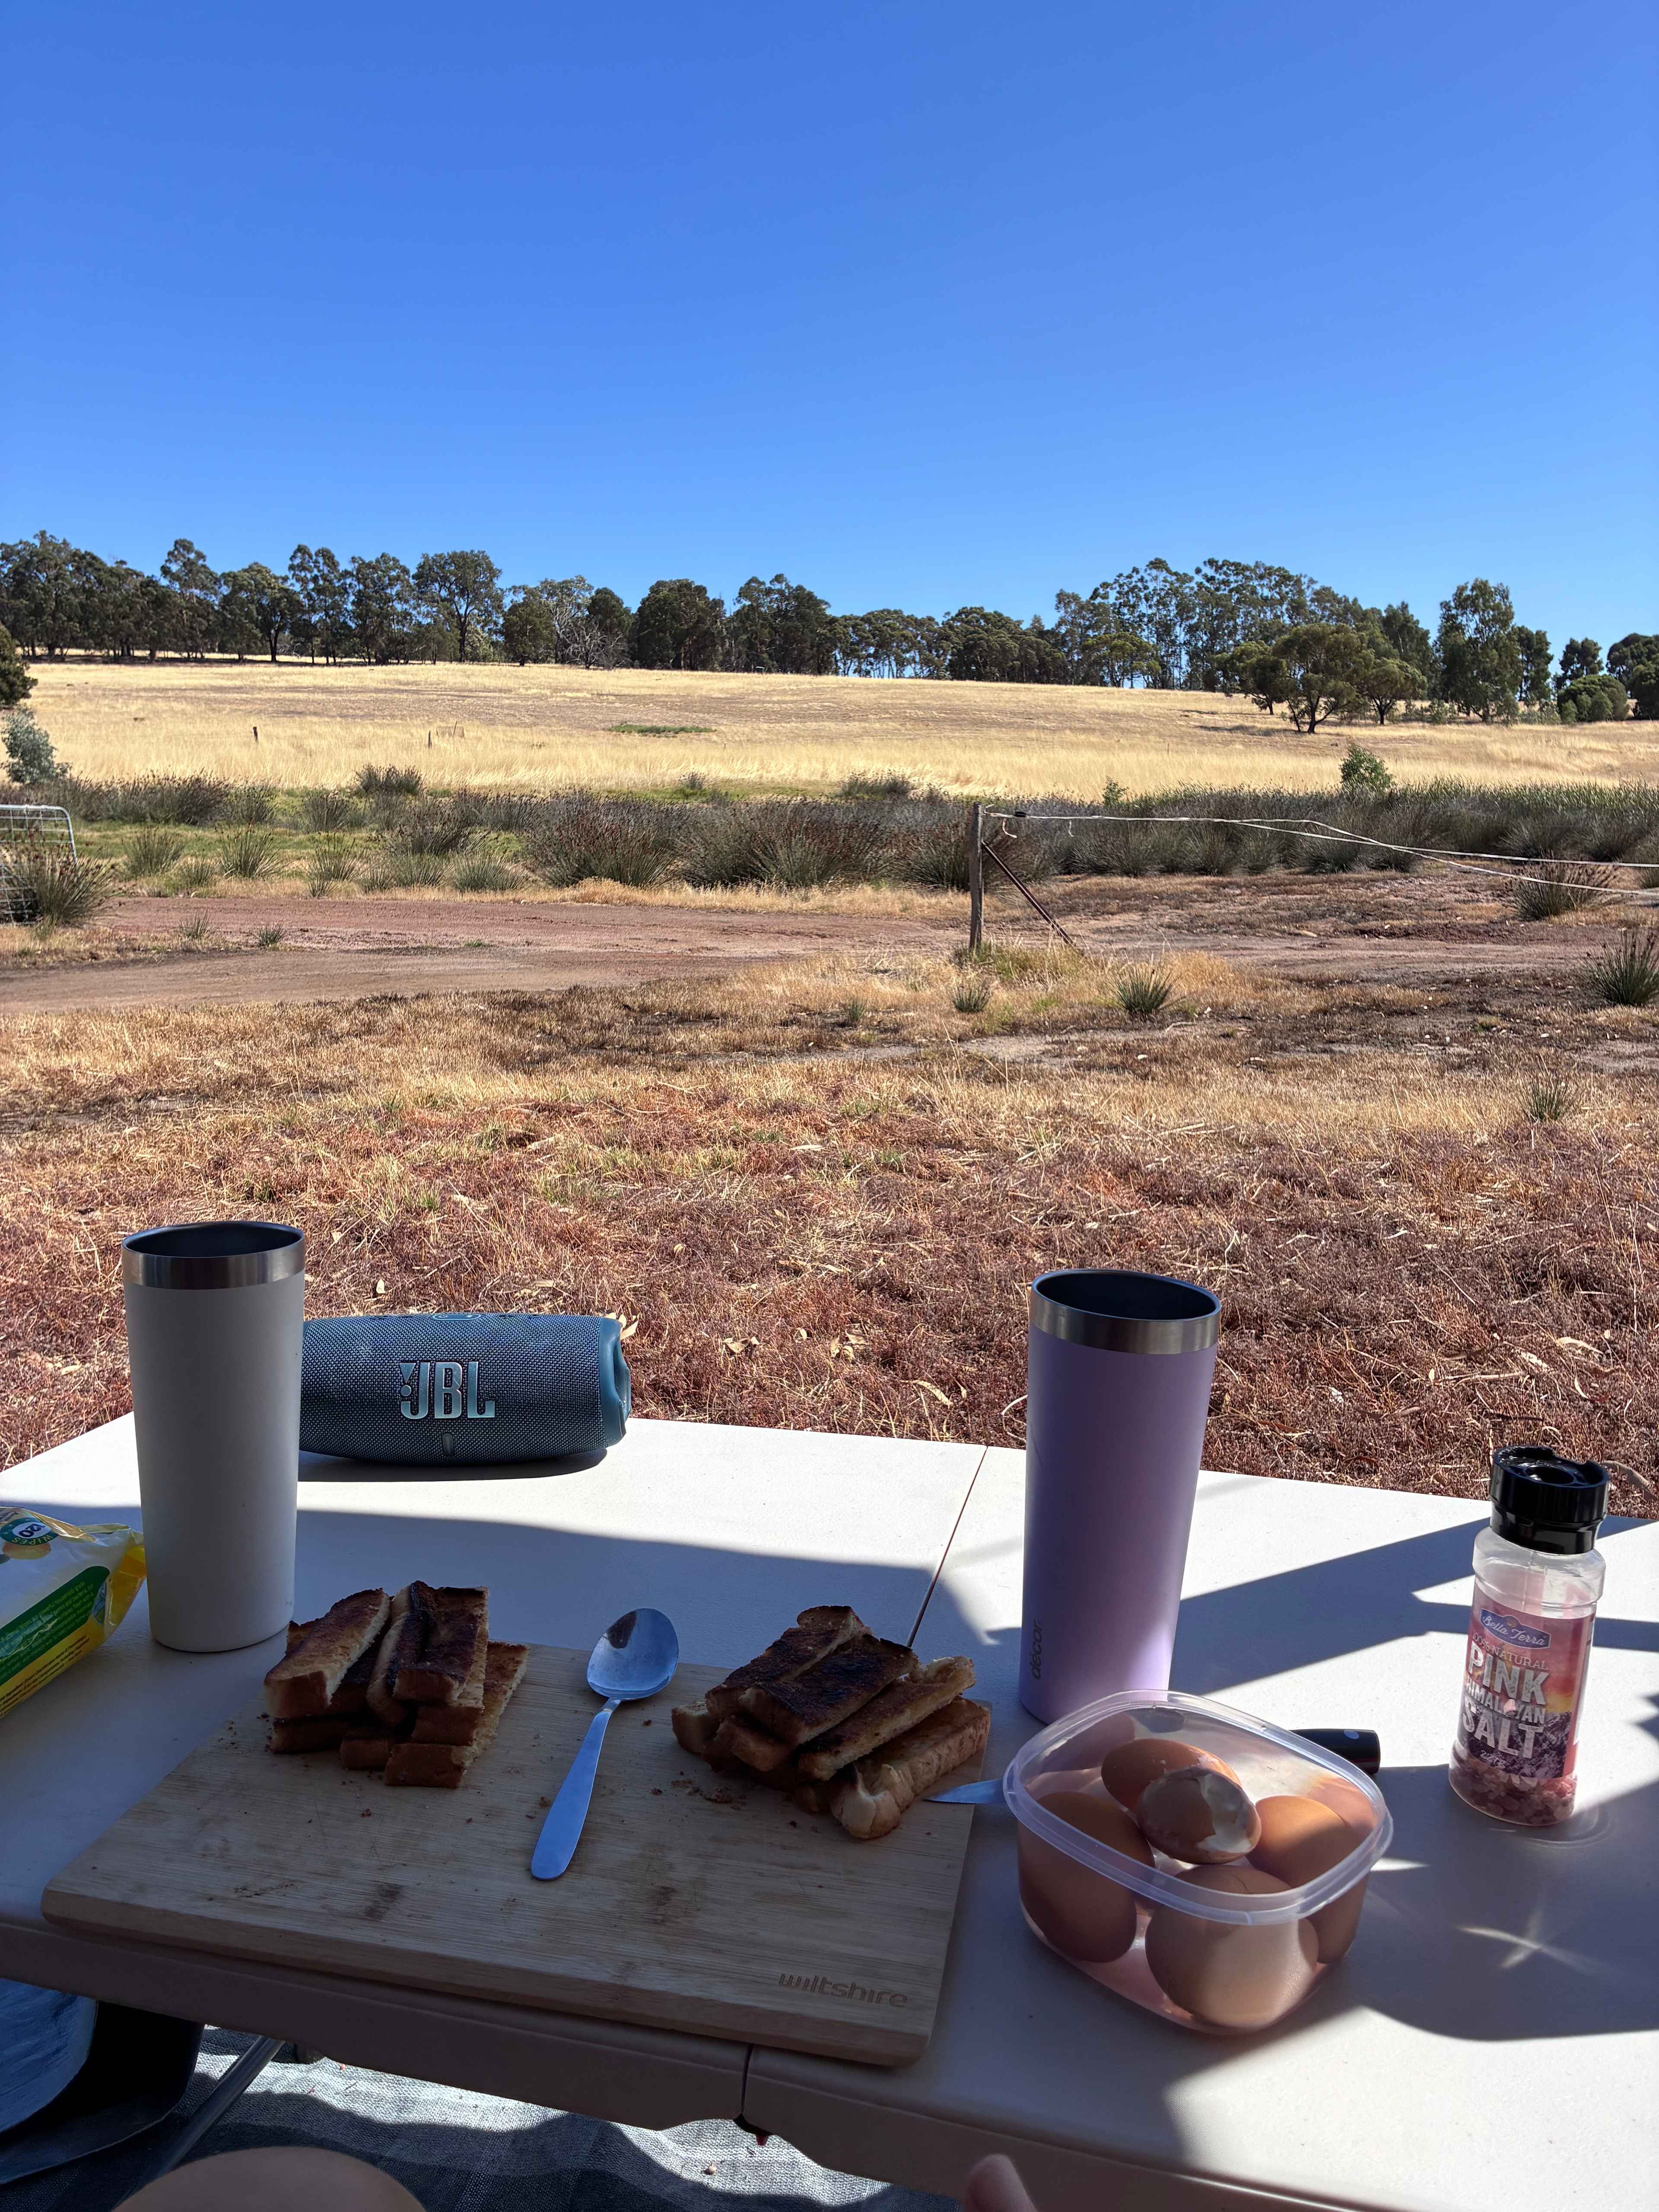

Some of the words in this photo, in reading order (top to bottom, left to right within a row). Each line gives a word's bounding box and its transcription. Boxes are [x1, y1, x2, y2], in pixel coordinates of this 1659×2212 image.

[400, 1361, 495, 1419] JBL
[12, 1534, 53, 1545] WIPES
[1482, 1615, 1508, 1635] Bella
[1510, 1628, 1545, 1646] Terra
[1468, 1640, 1550, 1705] PINK
[1491, 1647, 1548, 1670] NATURAL
[1462, 1694, 1545, 1759] SALT
[779, 1973, 907, 2008] wiltshire
